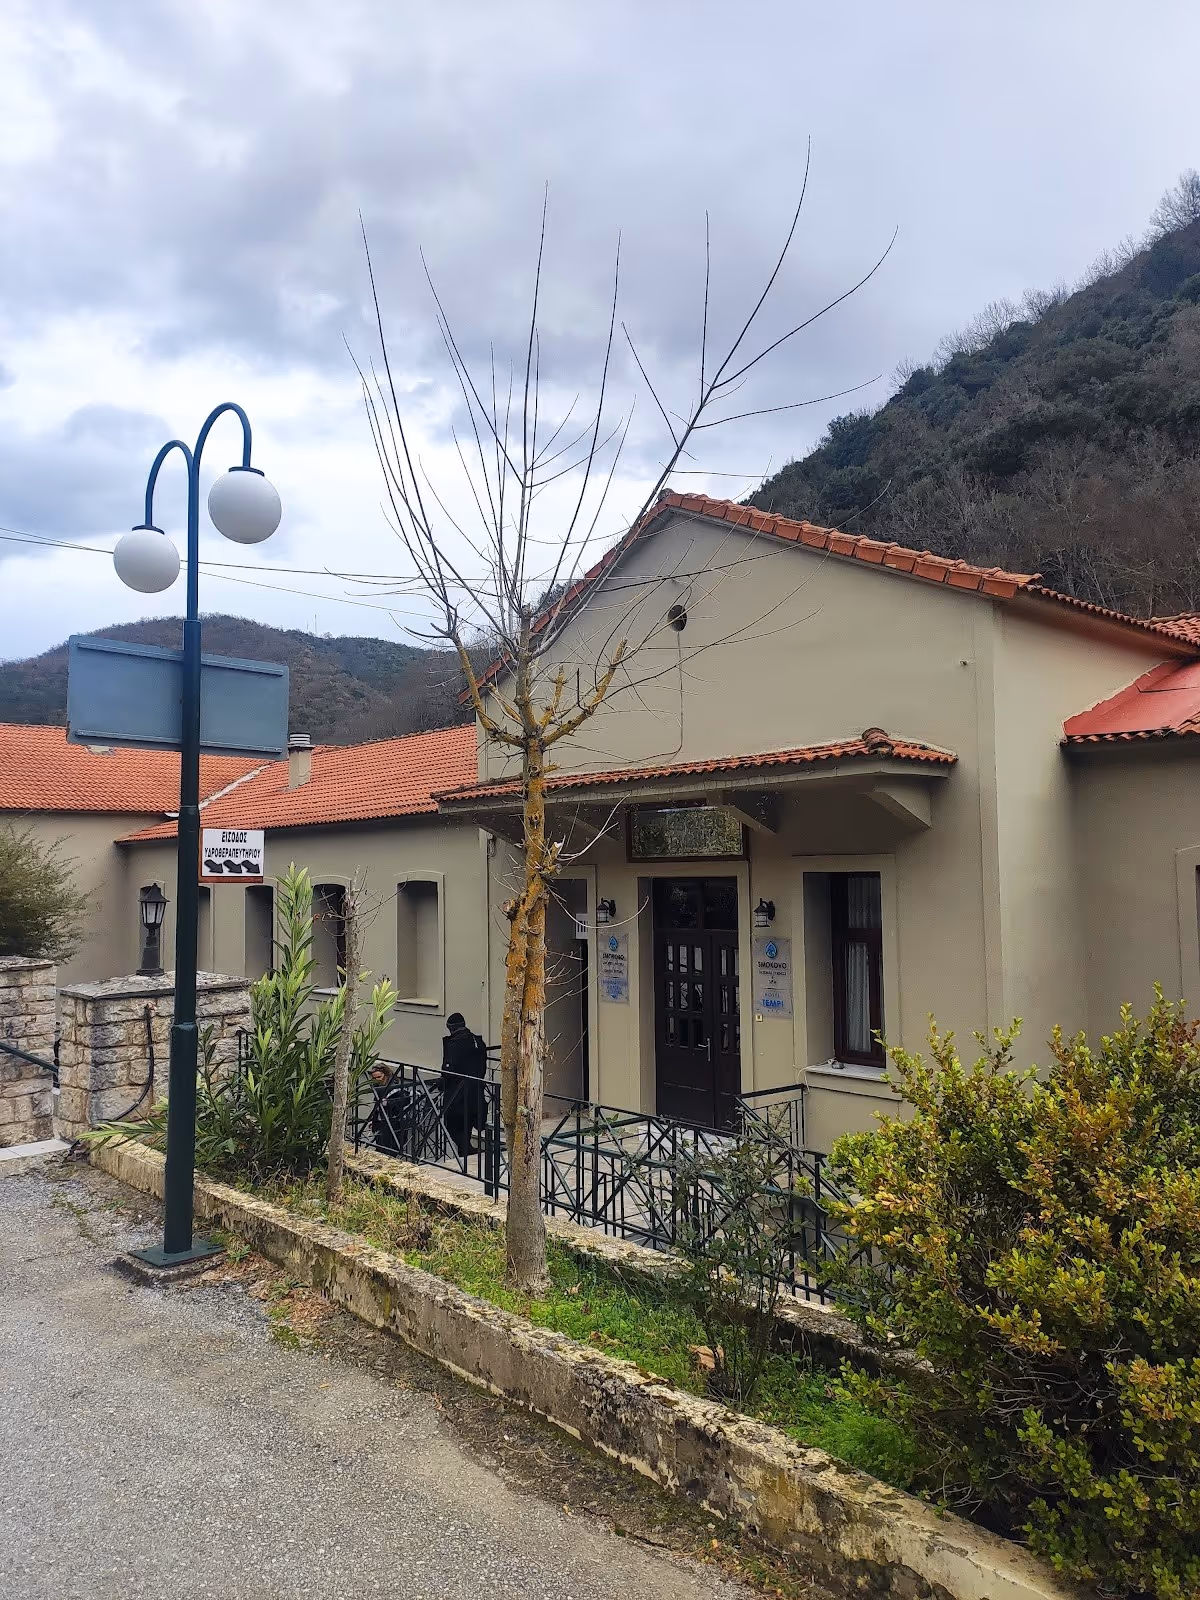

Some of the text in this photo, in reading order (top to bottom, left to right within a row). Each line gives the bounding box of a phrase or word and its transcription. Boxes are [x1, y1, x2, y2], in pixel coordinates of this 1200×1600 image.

[221, 831, 248, 843] ΕΙΣΟΔΟΣ
[204, 847, 262, 858] ΥΔΡΟΘΕΡΑΠΕΥΤΗΡΙΟΥ
[757, 961, 787, 969] SMOKOVO
[762, 998, 784, 1008] TEMPI
